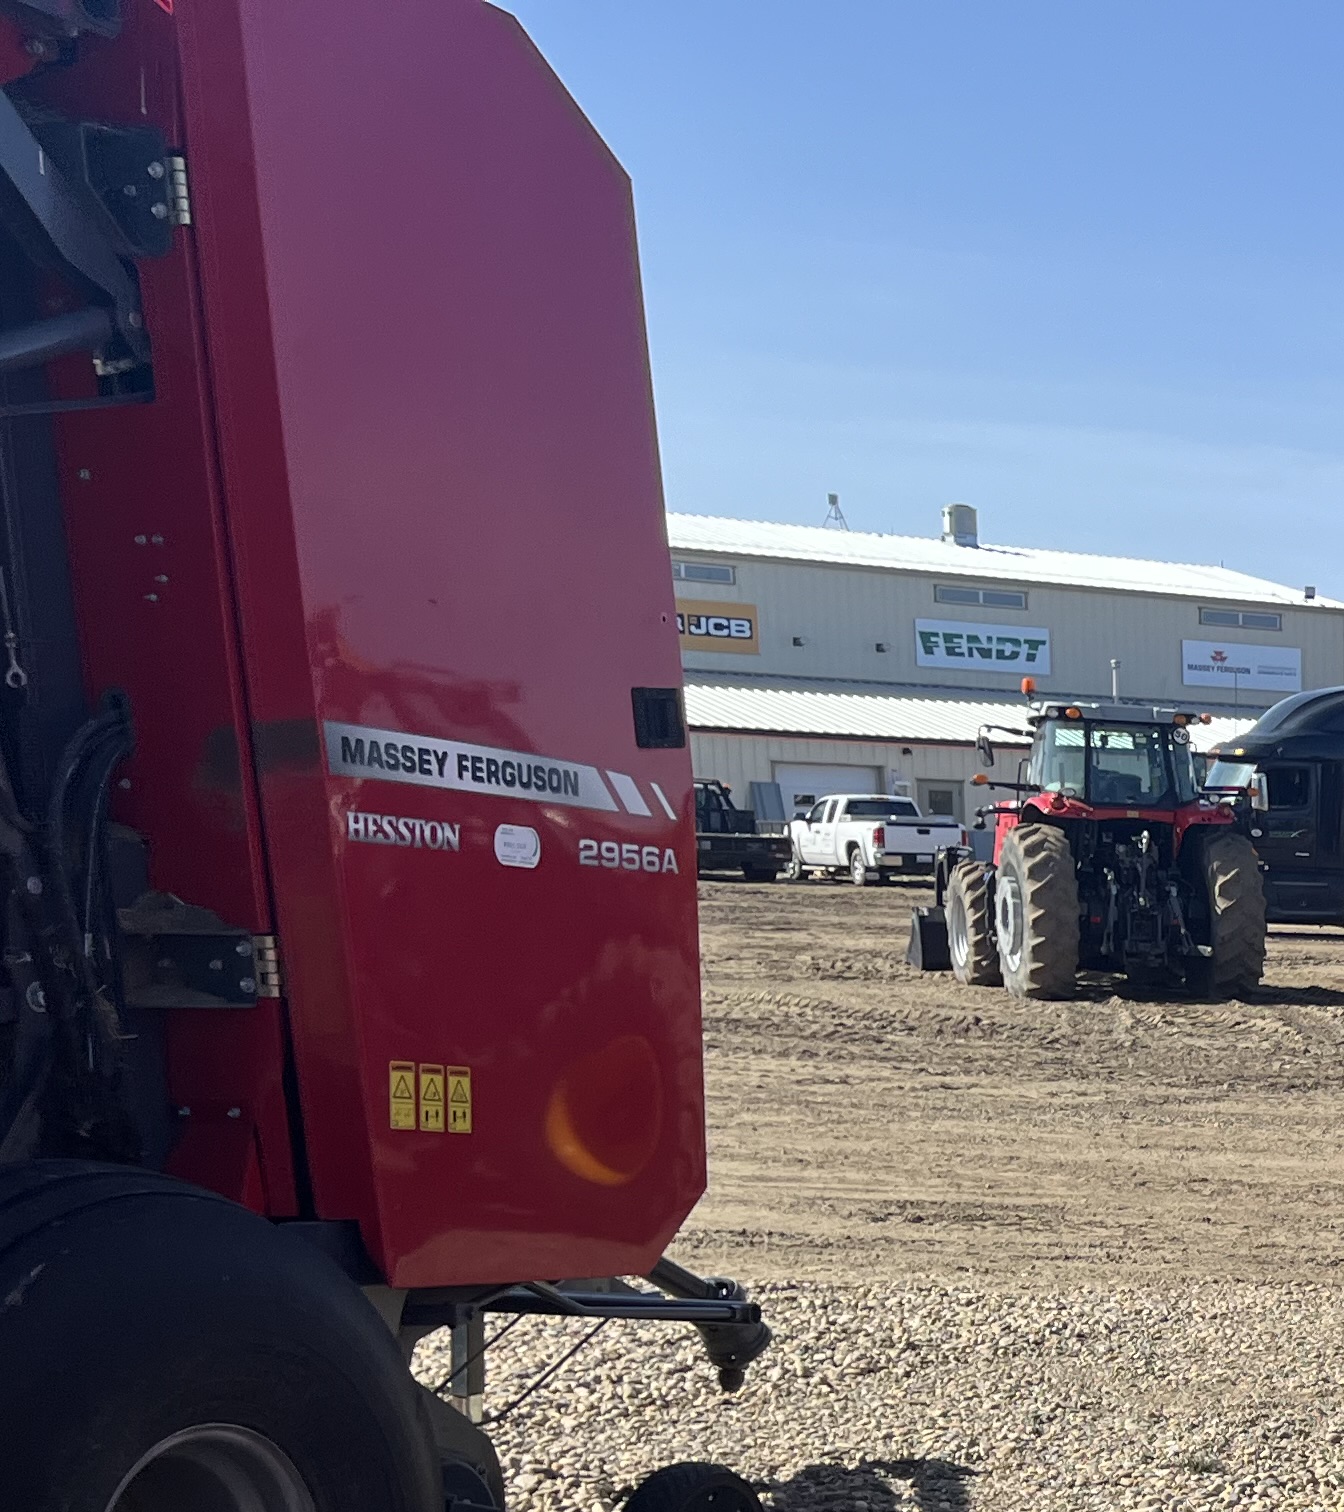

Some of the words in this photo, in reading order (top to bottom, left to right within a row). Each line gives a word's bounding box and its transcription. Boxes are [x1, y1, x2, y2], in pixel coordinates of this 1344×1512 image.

[689, 616, 752, 638] JCB
[918, 631, 1047, 662] FENDT
[1187, 664, 1215, 673] MASSEY
[340, 736, 449, 778] MASSEY
[457, 752, 580, 798] FERGUSON
[346, 811, 461, 851] HESSTON
[578, 838, 679, 875] 2956A
